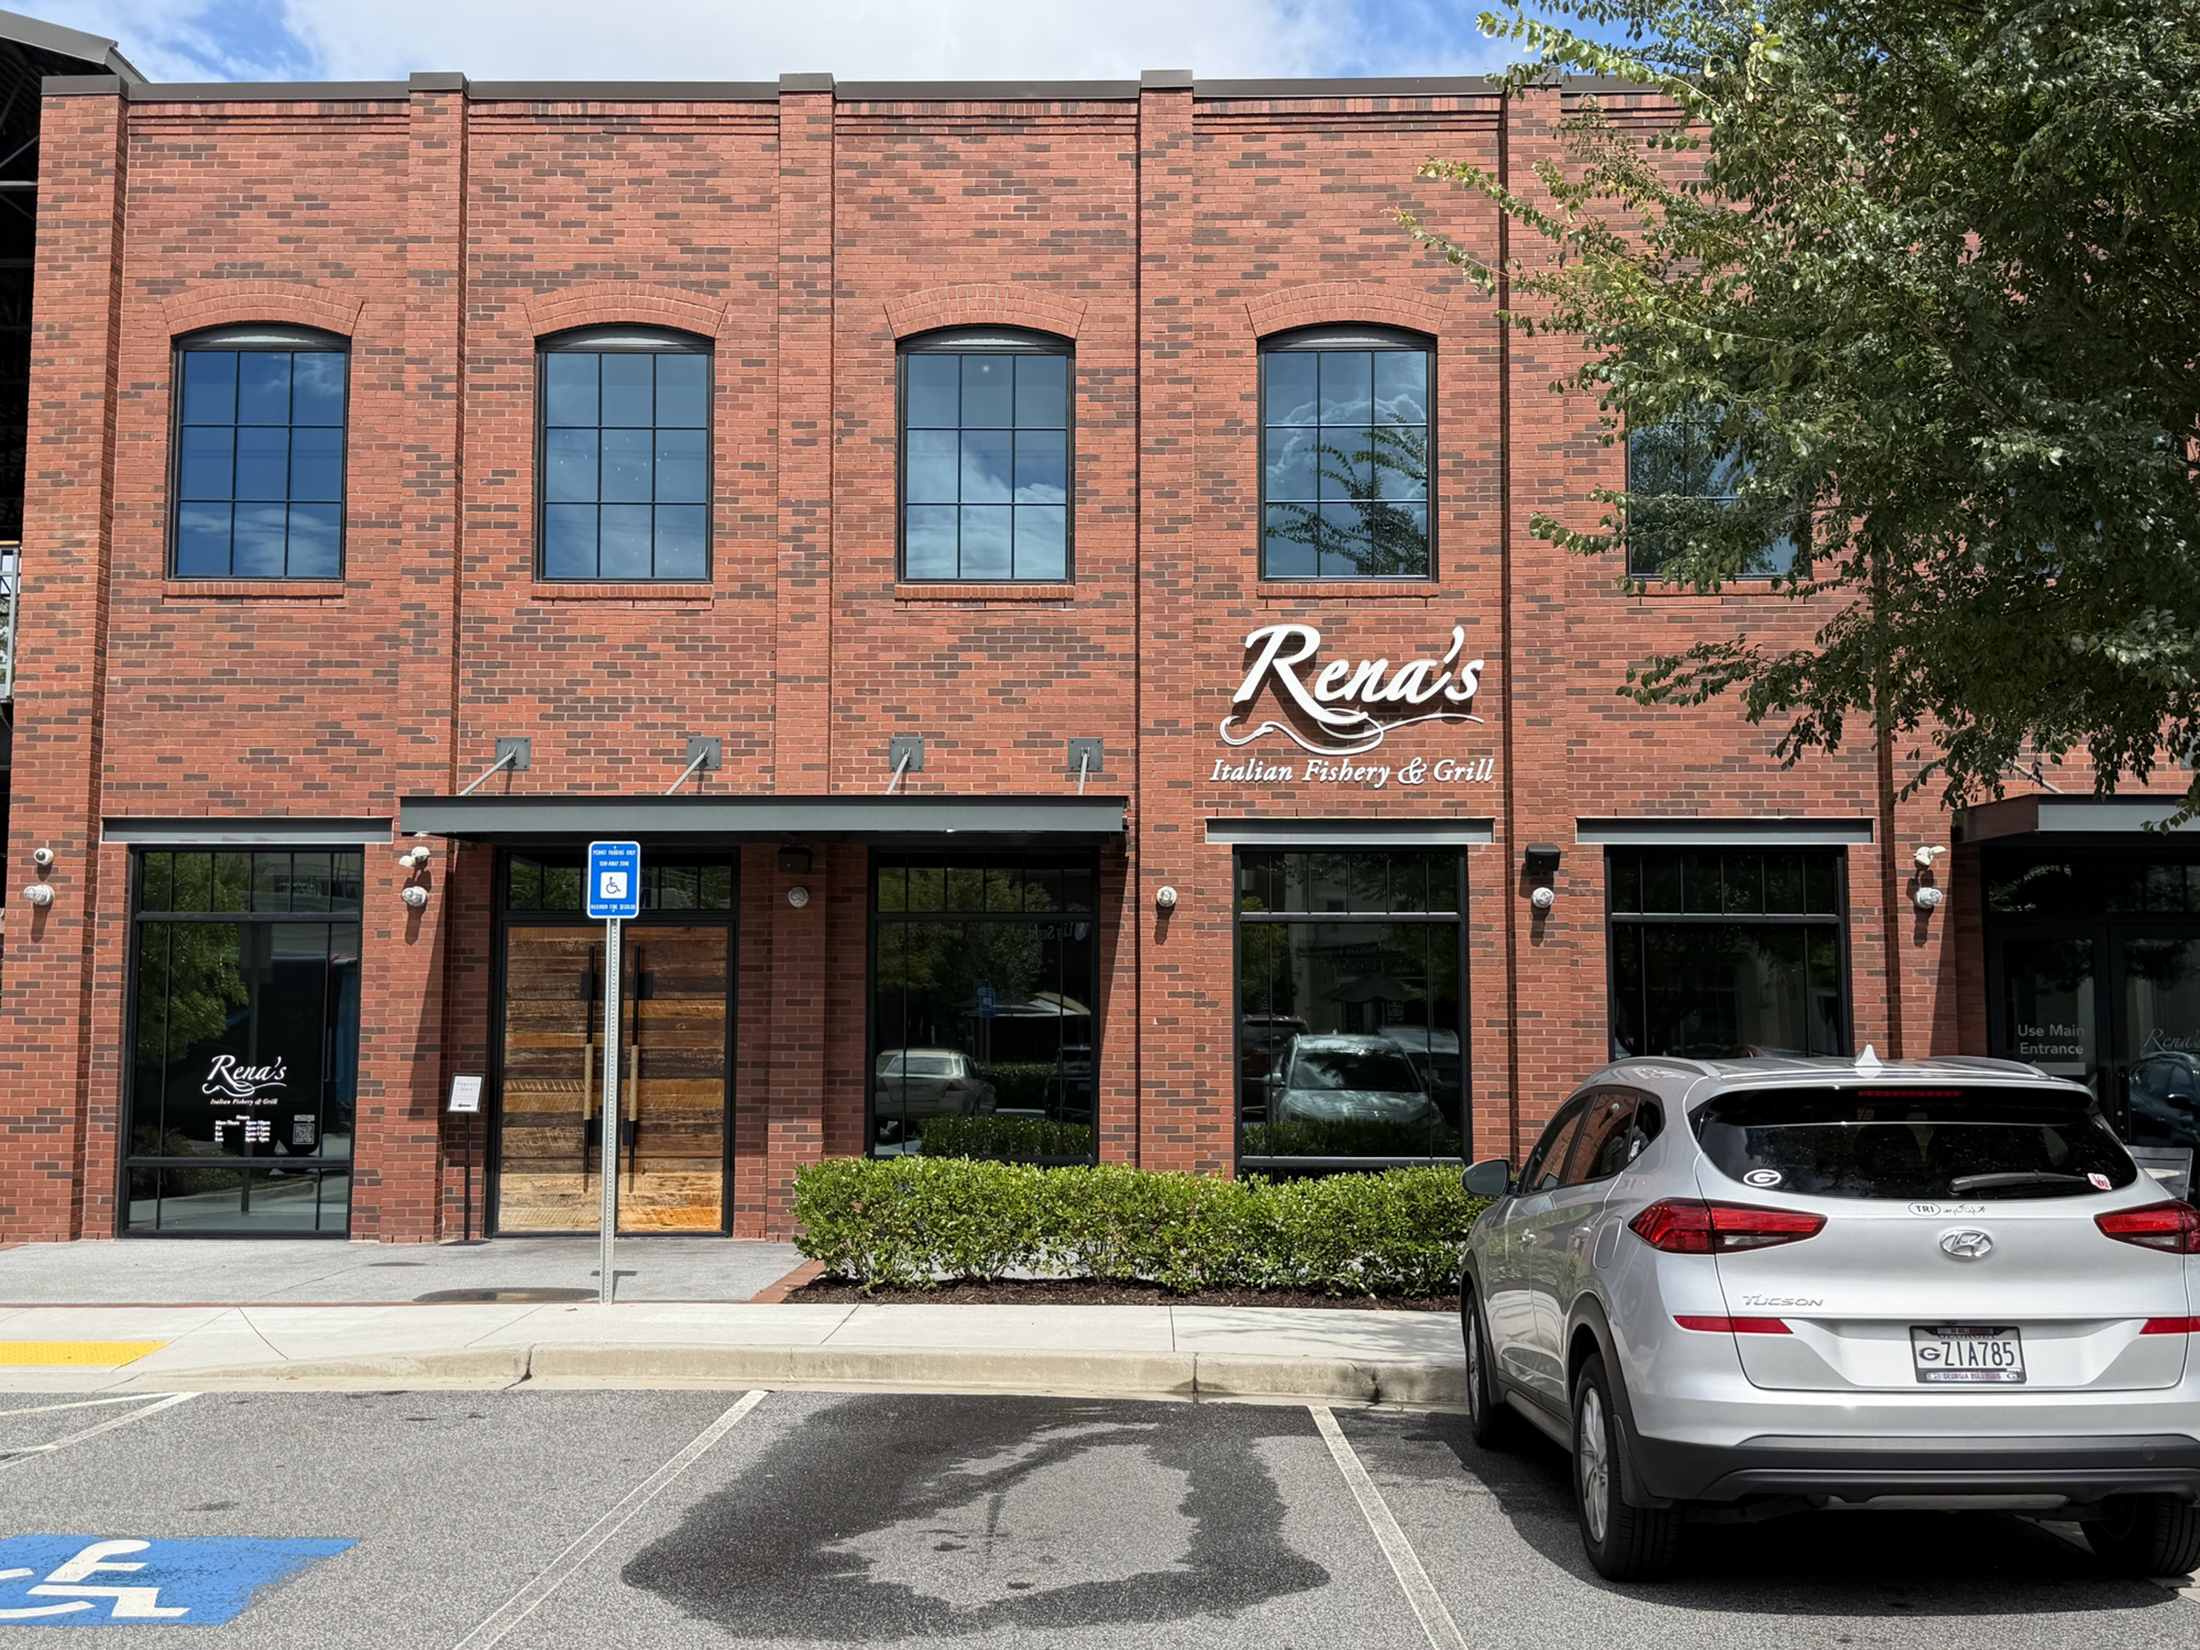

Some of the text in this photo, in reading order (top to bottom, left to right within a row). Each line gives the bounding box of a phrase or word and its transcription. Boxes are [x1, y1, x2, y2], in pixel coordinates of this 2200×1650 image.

[1232, 623, 1485, 726] Rena's
[1209, 756, 1495, 789] Italian Fishery & Grill
[2017, 1024, 2085, 1037] Use Main
[2019, 1042, 2084, 1055] Entrance
[207, 1054, 287, 1087] Rena's
[232, 1098, 254, 1106] Fishery
[1915, 1205, 1935, 1213] TRI
[1743, 1294, 1823, 1307] TUCSON
[1941, 1341, 2015, 1366] ZIA785
